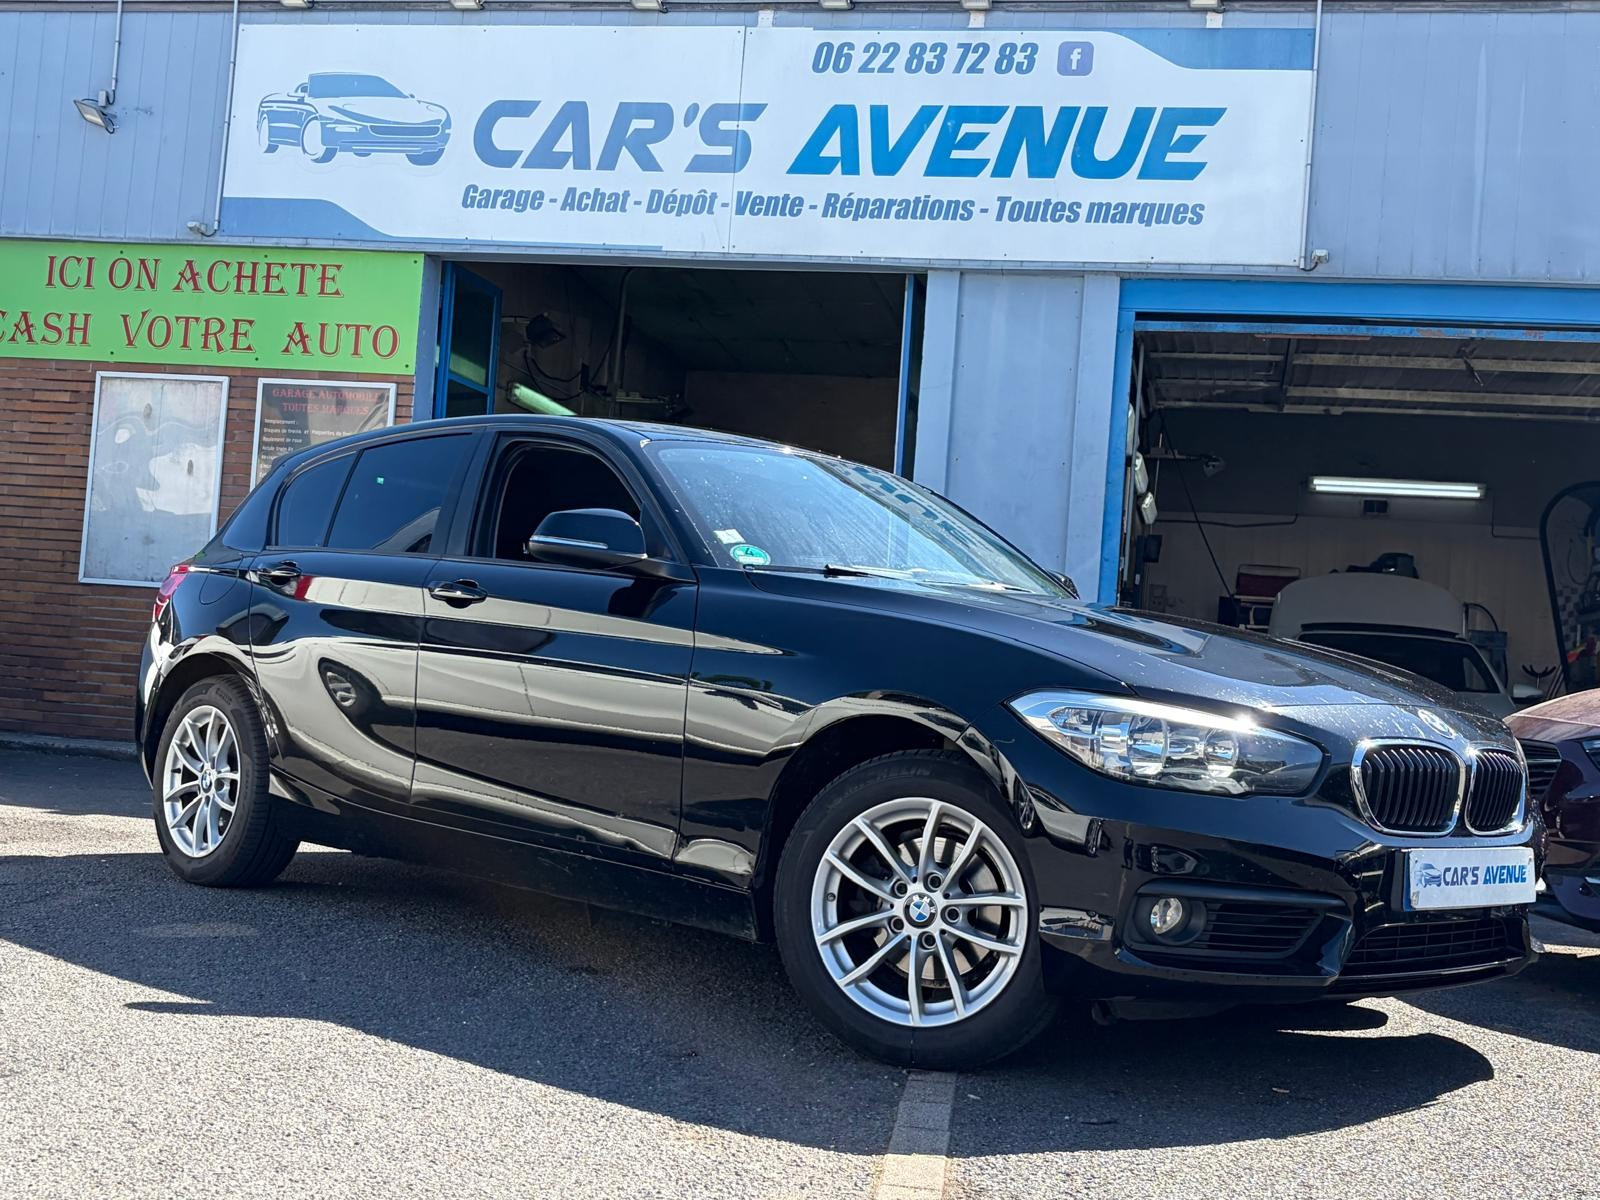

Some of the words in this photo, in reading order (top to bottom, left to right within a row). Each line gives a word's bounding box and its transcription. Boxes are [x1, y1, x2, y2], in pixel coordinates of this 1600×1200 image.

[812, 42, 854, 74] 06
[857, 42, 900, 75] 22
[904, 43, 948, 75] 83
[952, 43, 993, 75] 72
[994, 43, 1039, 75] 83
[473, 99, 769, 174] CAR'S
[786, 104, 1228, 181] AVENUE
[461, 184, 543, 213] Garage
[560, 186, 630, 214] Achat
[645, 186, 718, 217] Dépôt
[734, 191, 804, 218] Vente
[821, 191, 975, 222] Réparations
[995, 195, 1081, 224] Toutes
[1085, 201, 1205, 228] marques
[45, 255, 95, 290] ICI
[108, 257, 161, 292] ON
[172, 259, 344, 298] ACHETE
[120, 309, 256, 354] VOTRE
[281, 321, 400, 360] AUTO
[273, 388, 316, 399] GARAGE
[318, 390, 380, 402] AUTOMOBILE
[283, 403, 320, 413] TOUTES
[1442, 866, 1479, 887] CAR'S
[1483, 864, 1527, 886] AVENUE
